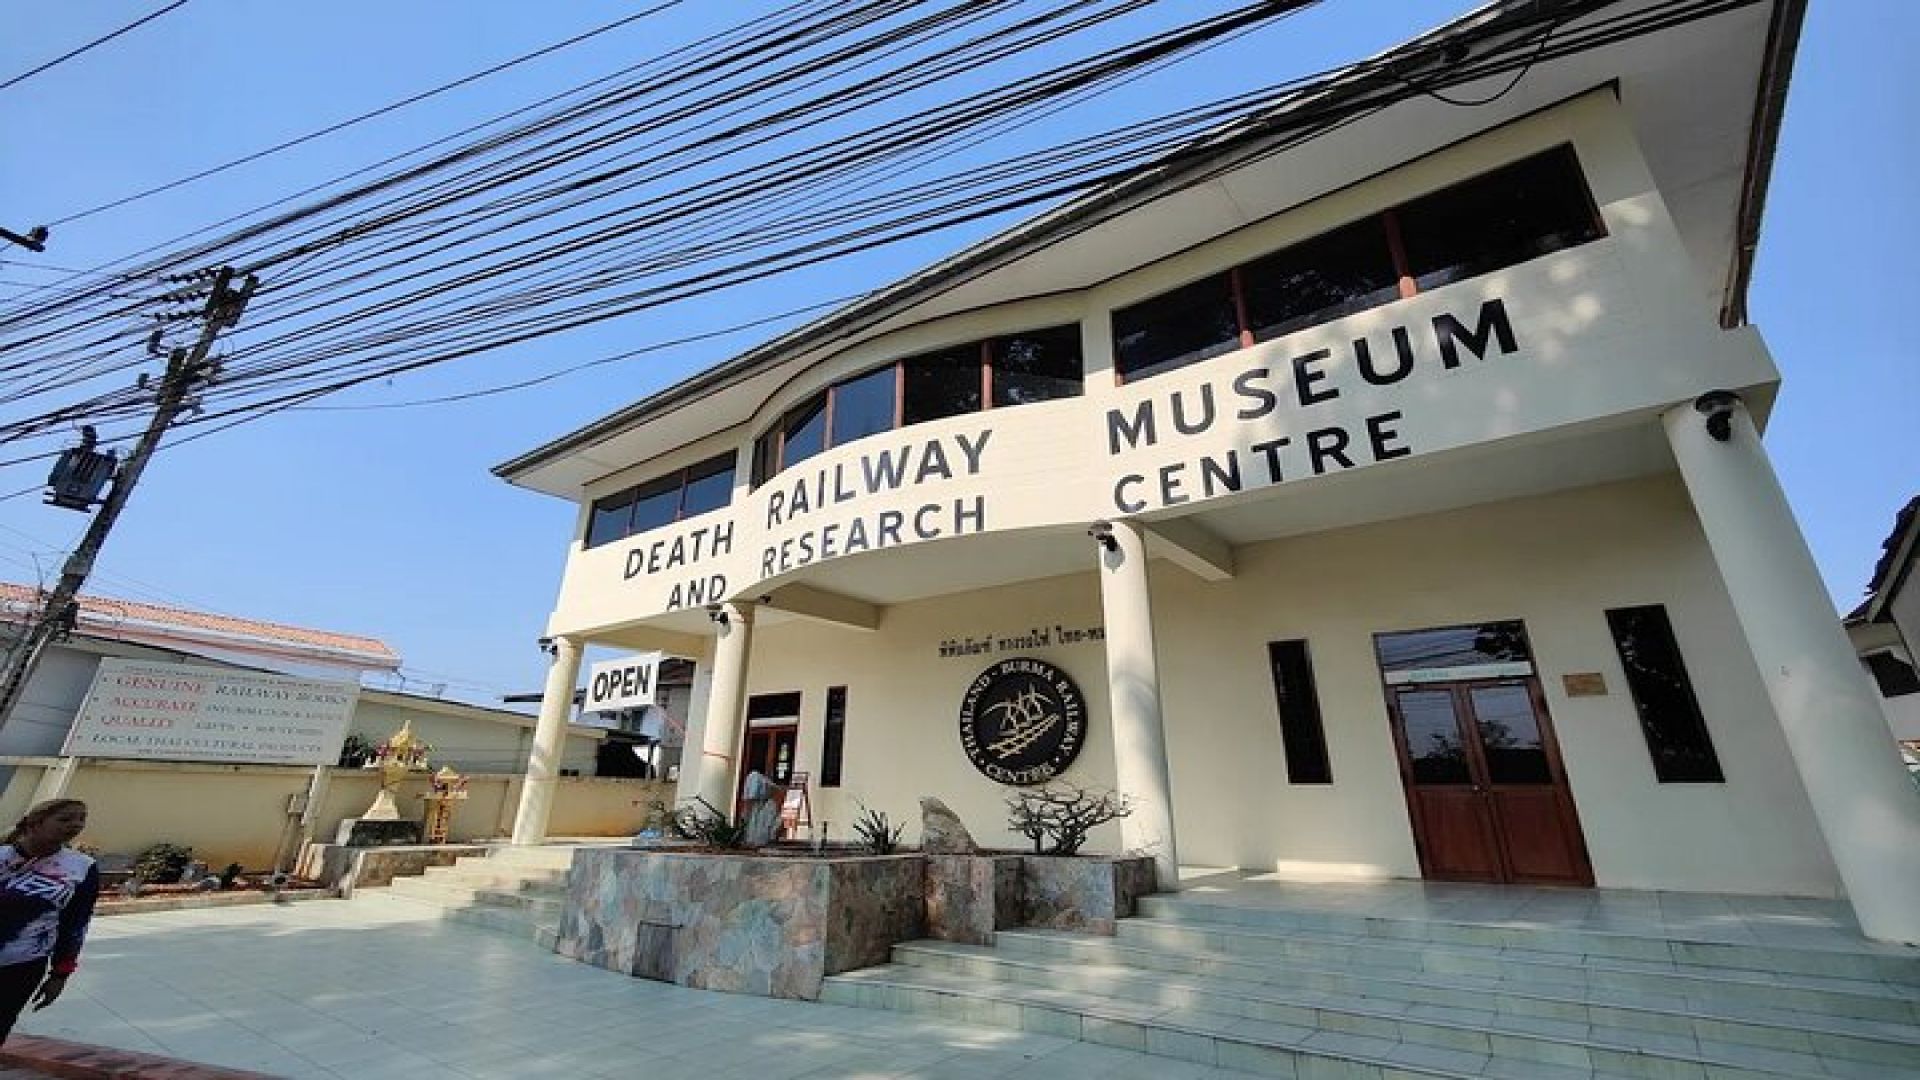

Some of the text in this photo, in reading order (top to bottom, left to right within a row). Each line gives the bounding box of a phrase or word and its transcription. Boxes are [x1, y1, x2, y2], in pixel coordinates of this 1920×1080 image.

[623, 298, 1519, 581] DEATH RAILWAY MUSEUM
[666, 411, 1412, 611] AND RESEARCH CENTRE
[115, 675, 206, 696] GENUINE
[214, 685, 291, 702] RAILWAY
[295, 689, 349, 705] BOOKS
[593, 663, 652, 702] OPEN
[110, 695, 199, 713] ACCURATE
[1055, 680, 1080, 757] RAILWAY
[91, 732, 140, 745] LOCAL
[99, 714, 175, 730] QUALITY
